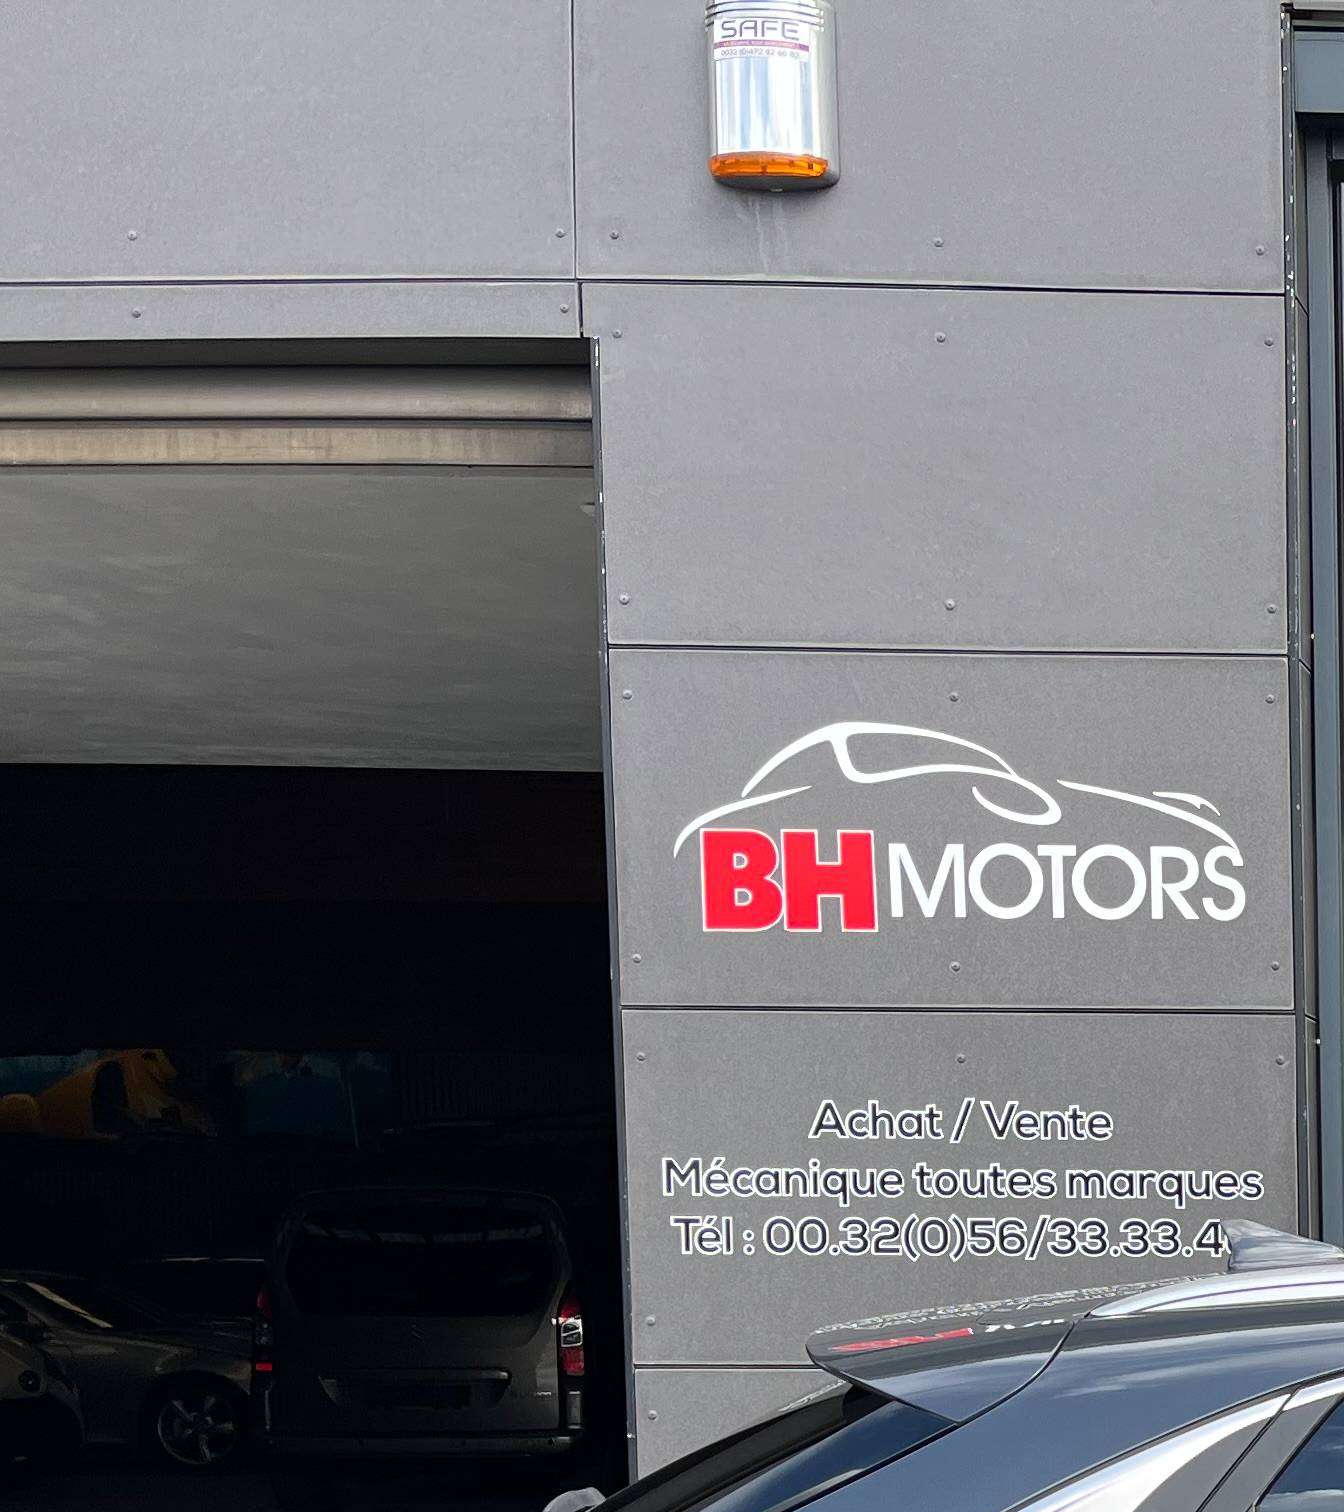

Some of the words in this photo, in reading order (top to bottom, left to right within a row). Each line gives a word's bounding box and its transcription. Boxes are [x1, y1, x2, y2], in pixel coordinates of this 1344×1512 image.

[721, 20, 799, 41] SAFE
[699, 828, 879, 933] BH
[888, 841, 1247, 922] MOTORS
[808, 1099, 944, 1140] Achat
[980, 1100, 1114, 1141] Vente
[661, 1157, 905, 1208] Mécanique
[912, 1162, 1057, 1199] toutes
[1066, 1169, 1265, 1210] marques
[763, 1213, 1232, 1263] 00.32(0)56/33.33.4
